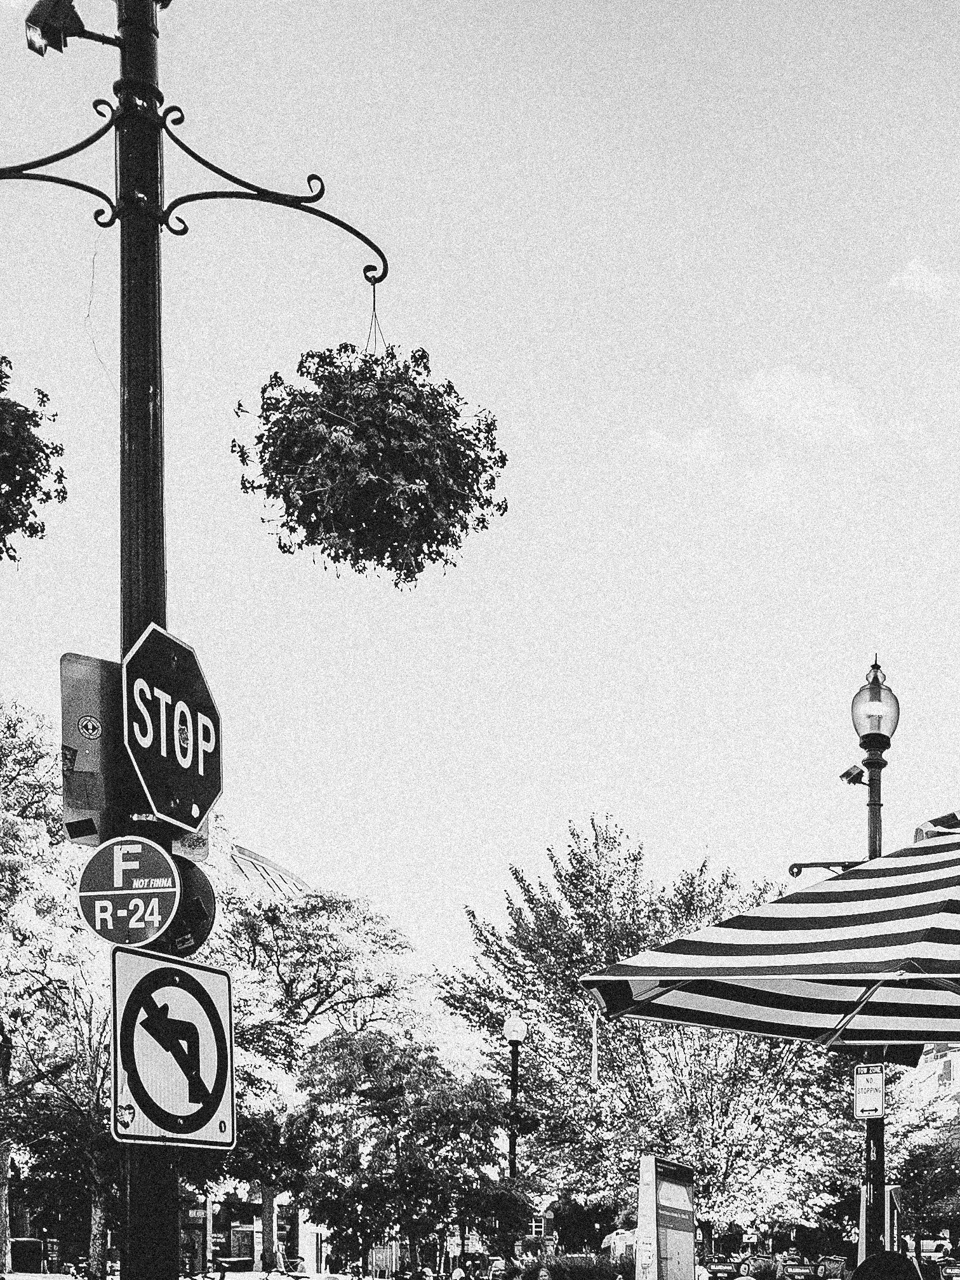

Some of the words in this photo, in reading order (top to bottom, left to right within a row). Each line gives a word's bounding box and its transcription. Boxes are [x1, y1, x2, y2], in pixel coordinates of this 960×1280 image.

[132, 677, 216, 776] STOP
[113, 843, 143, 888] F
[94, 897, 162, 931] R-24
